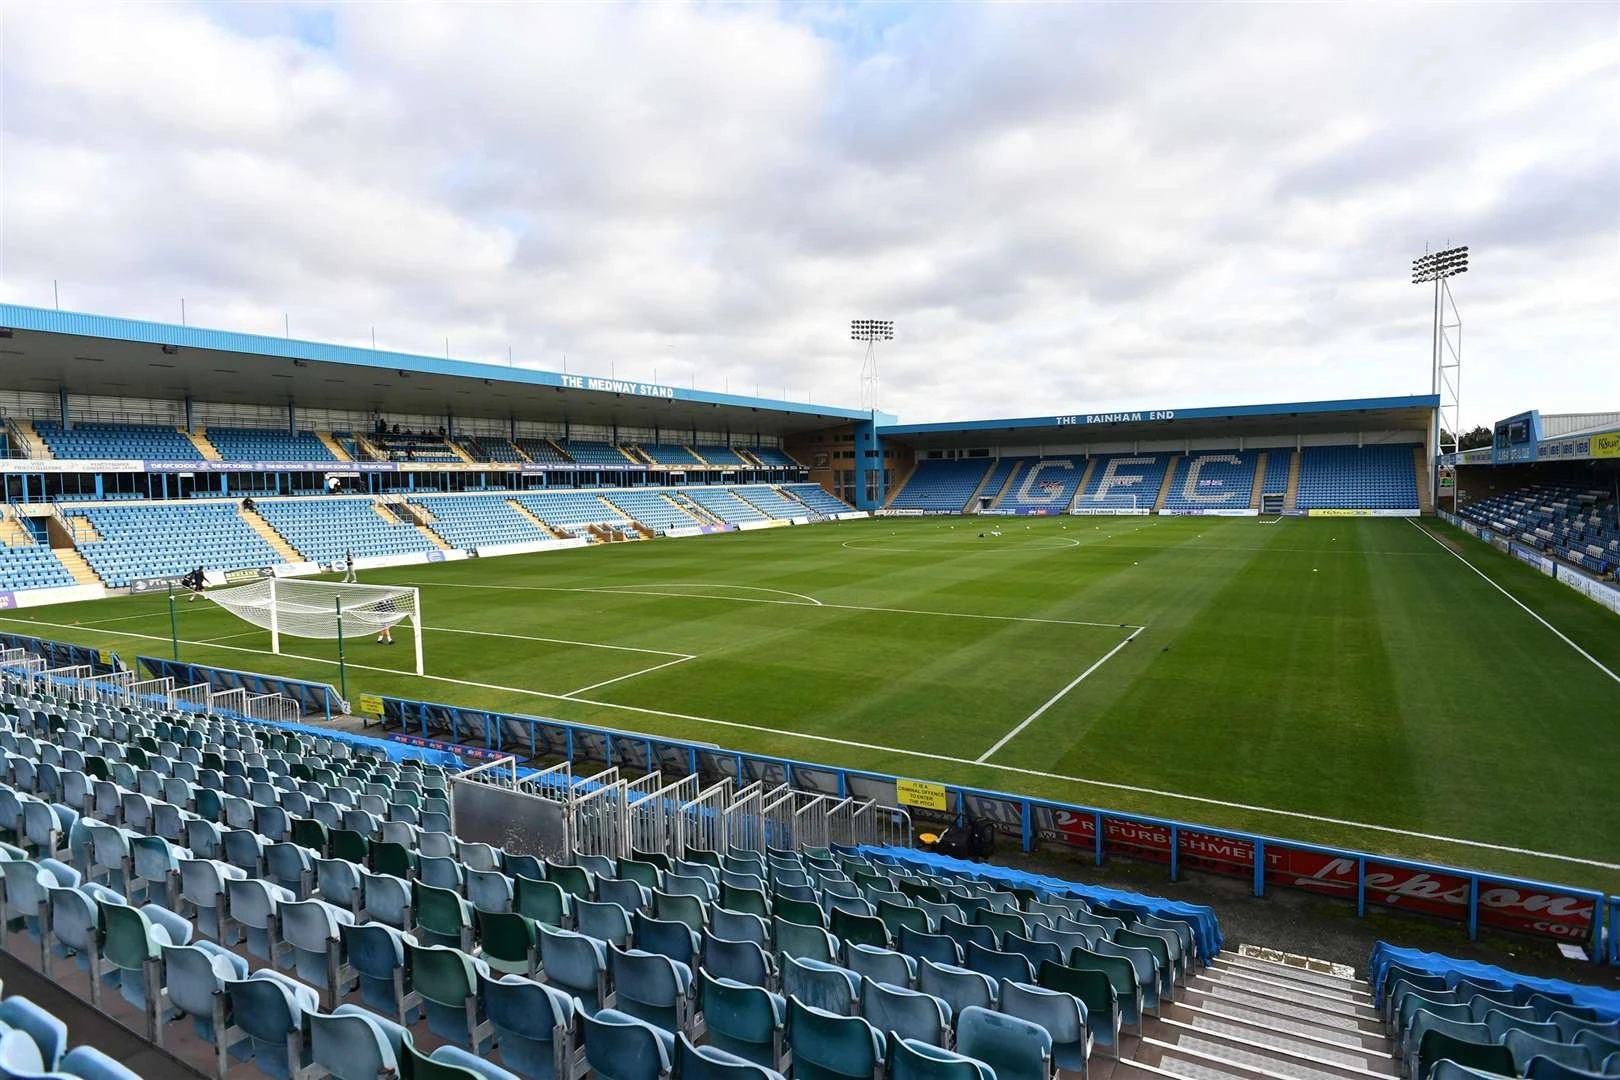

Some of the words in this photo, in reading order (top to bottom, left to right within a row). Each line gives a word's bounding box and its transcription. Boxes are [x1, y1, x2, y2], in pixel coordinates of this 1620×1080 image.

[561, 375, 583, 387] THE
[588, 379, 636, 394] MEDWAY
[640, 385, 673, 398] STAND
[1056, 417, 1076, 425] THE
[1087, 412, 1142, 424] RAINHAM
[1149, 411, 1174, 420] END
